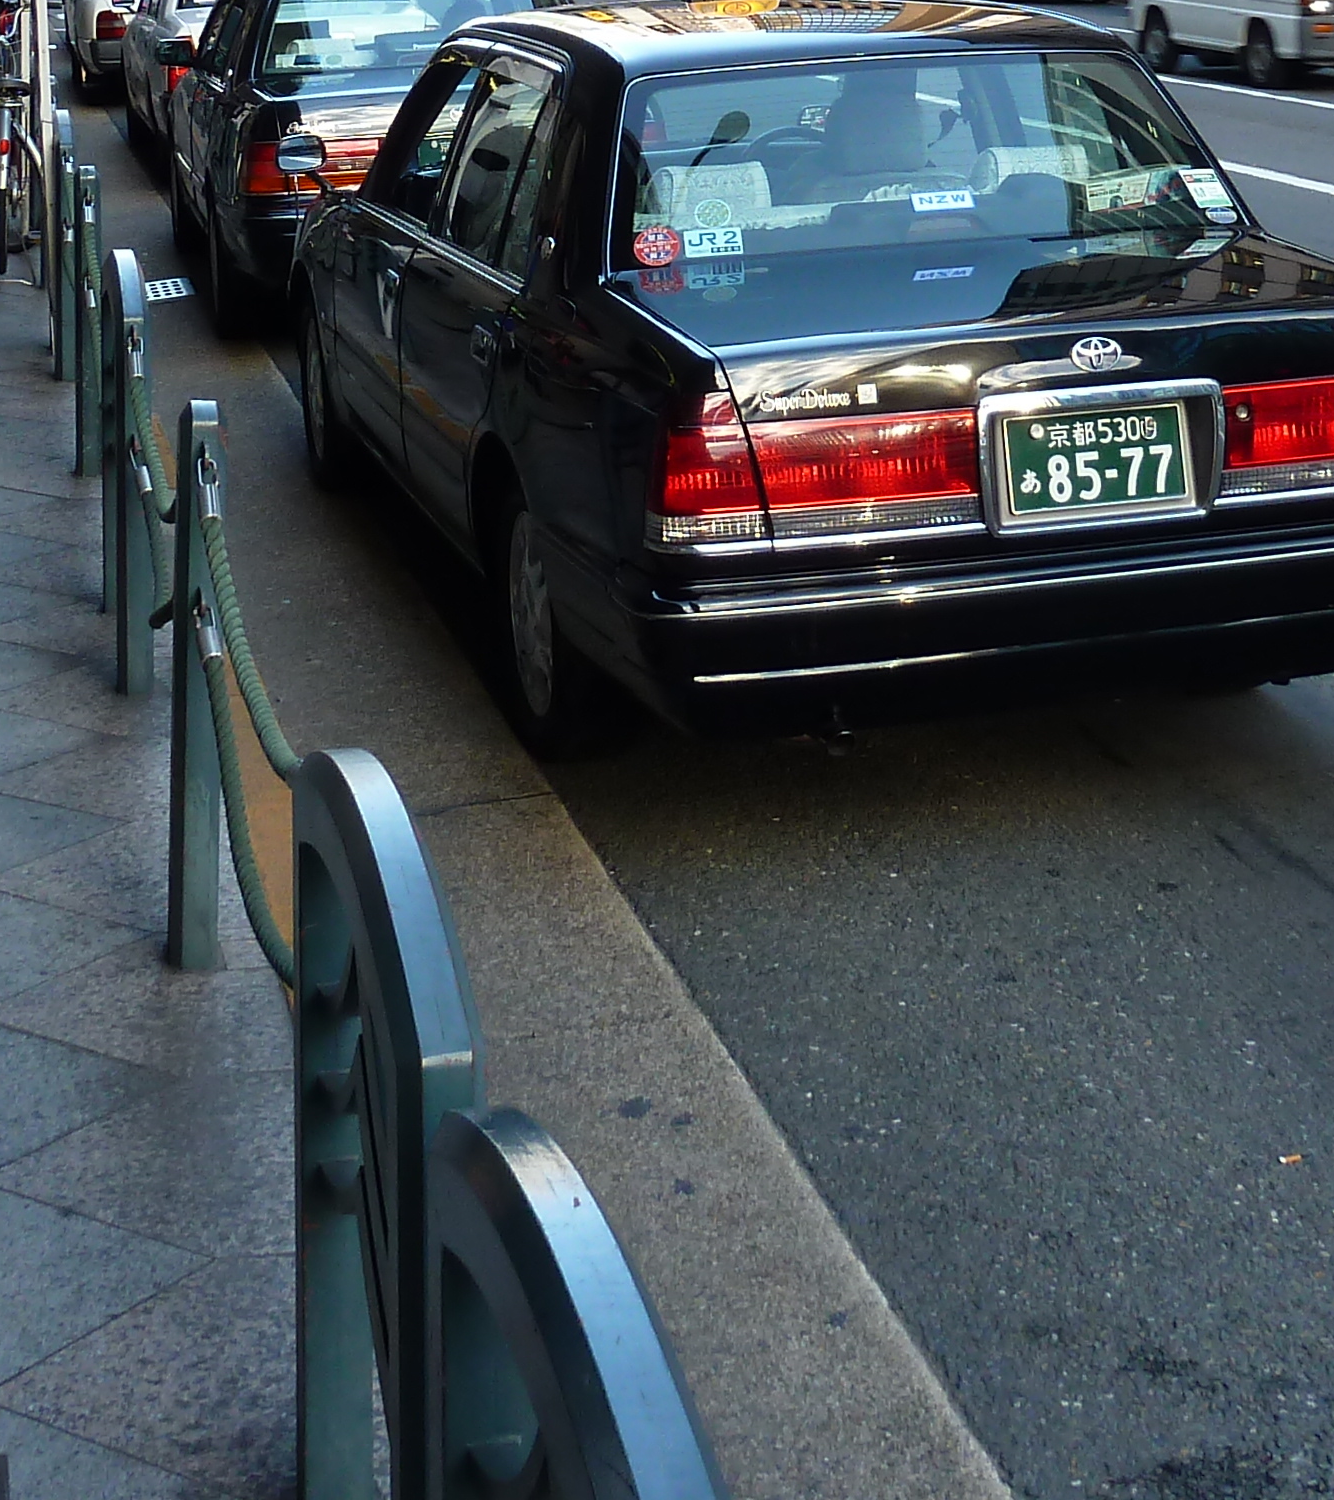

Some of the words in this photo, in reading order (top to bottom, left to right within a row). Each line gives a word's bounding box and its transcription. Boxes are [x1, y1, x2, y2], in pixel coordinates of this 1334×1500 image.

[688, 232, 717, 247] JR
[723, 231, 738, 244] 2
[760, 390, 799, 415] Super
[1020, 469, 1041, 494] あ
[1048, 444, 1173, 503] 85-77
